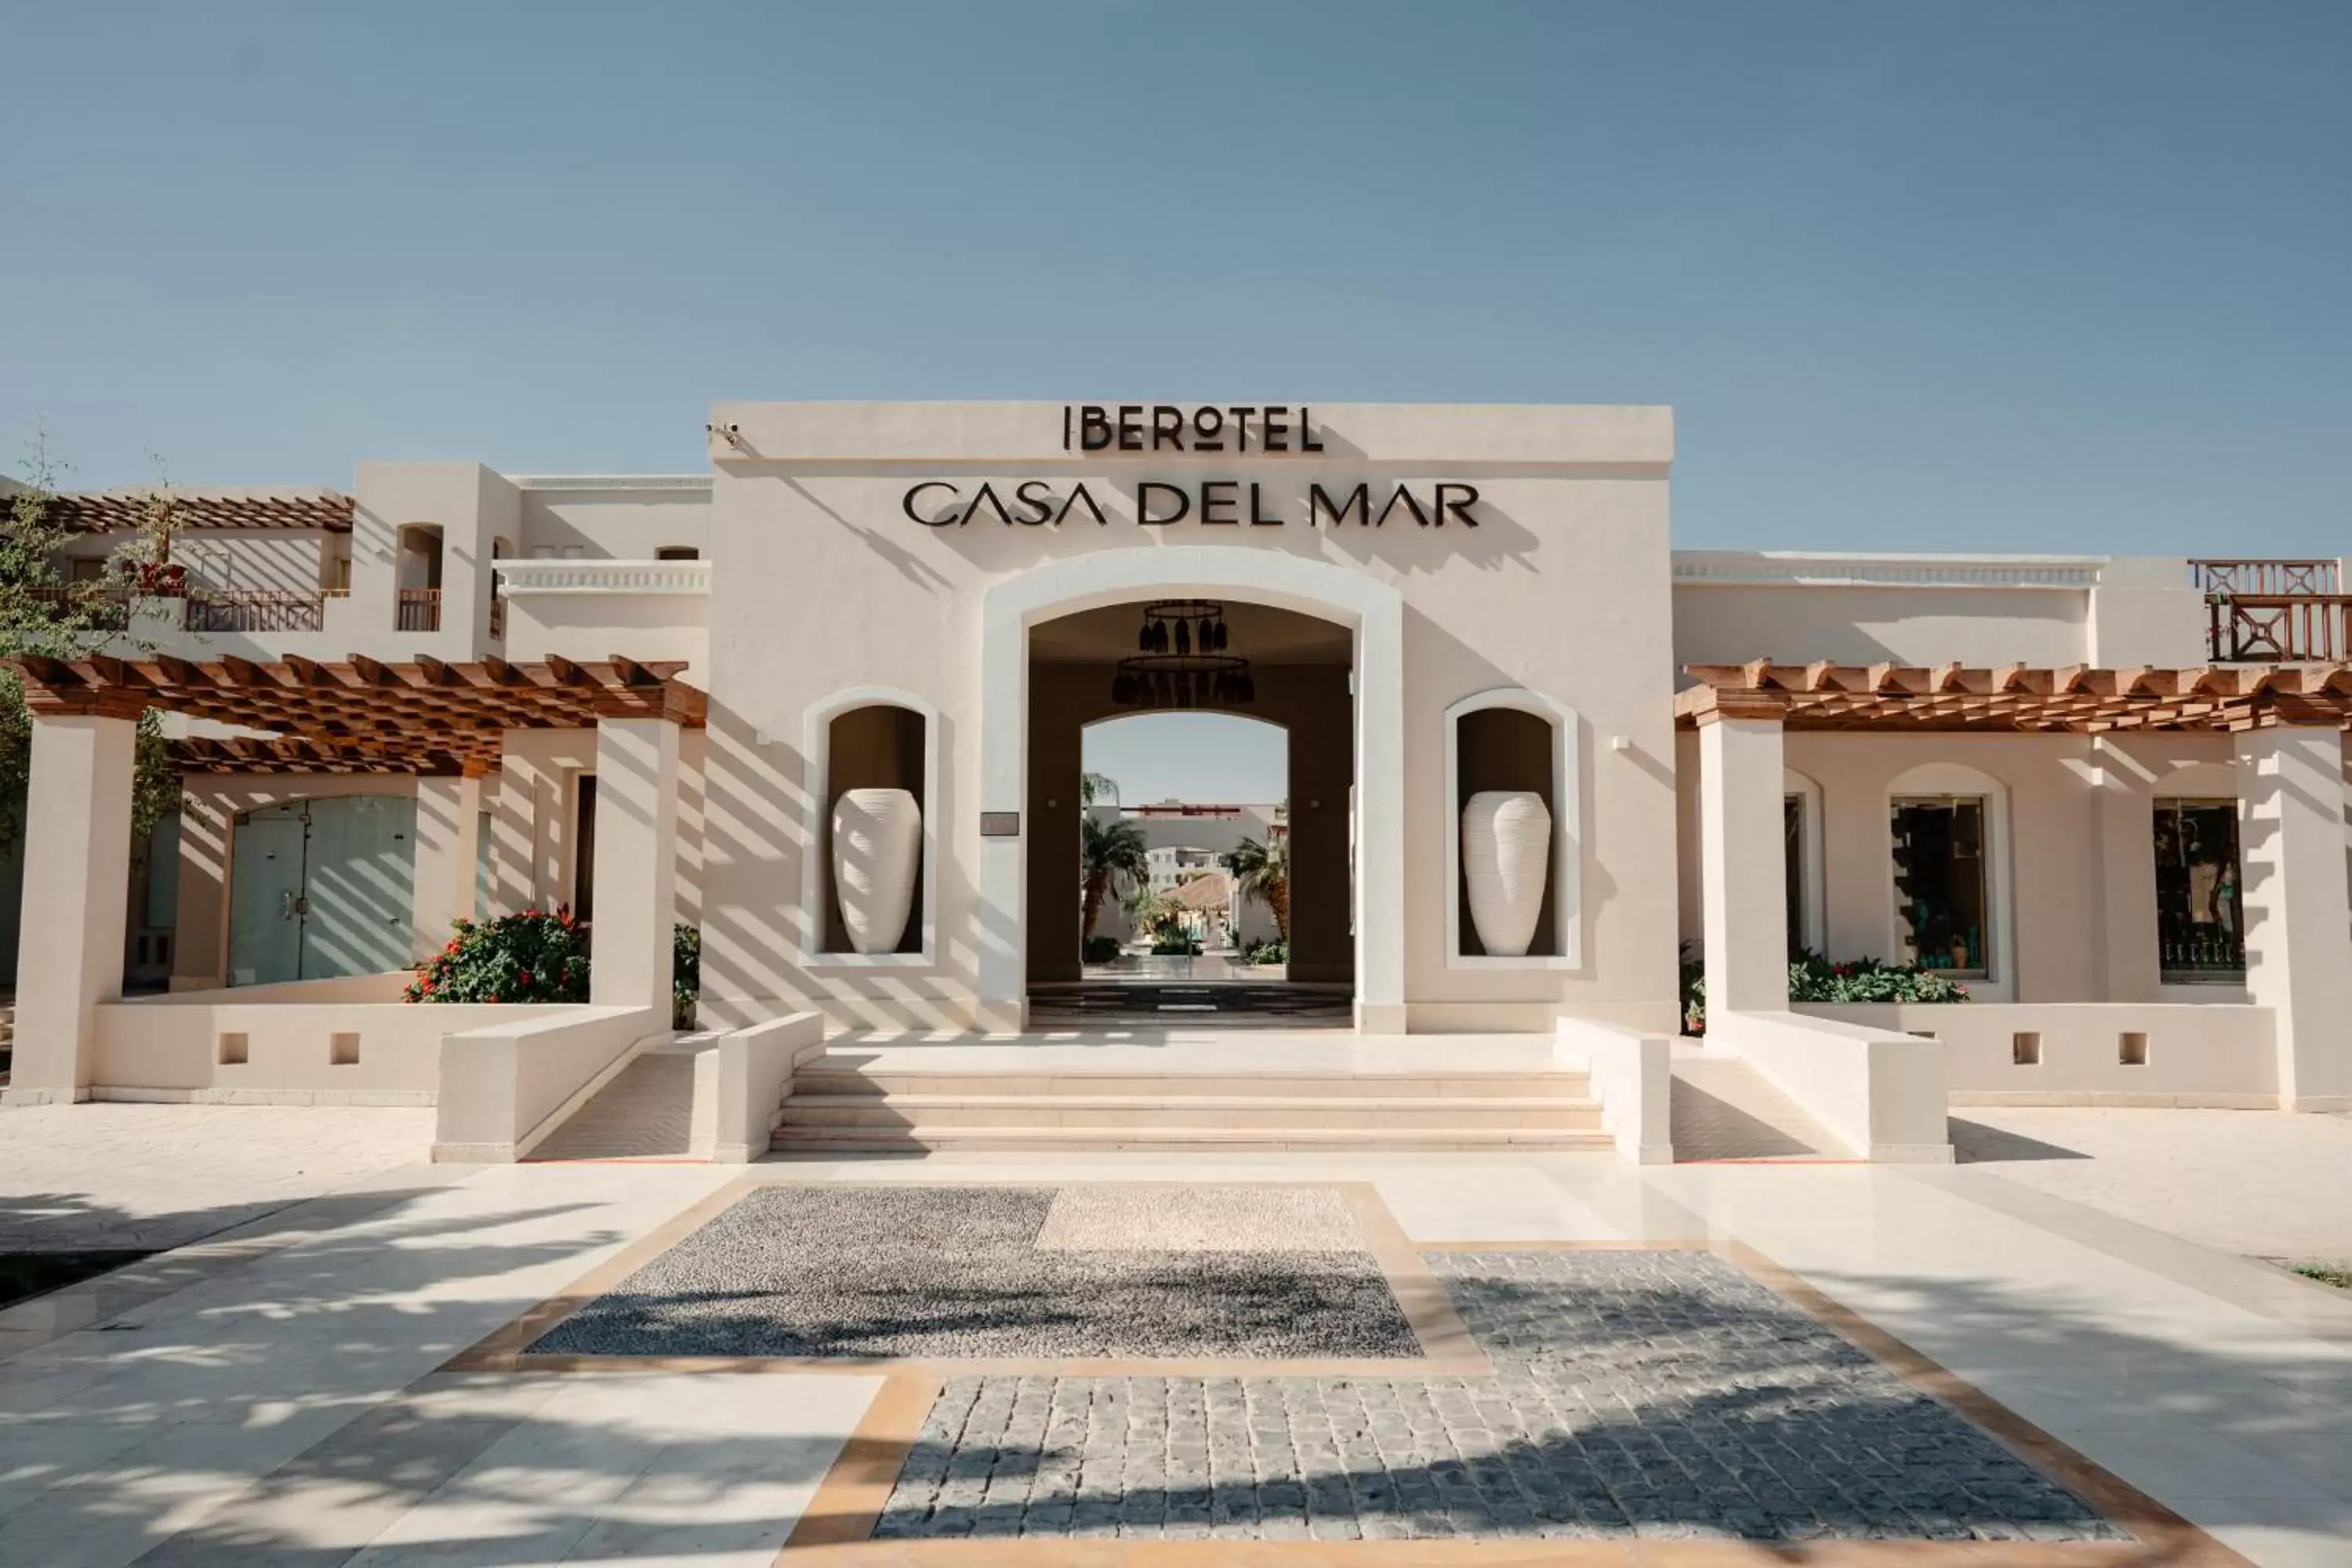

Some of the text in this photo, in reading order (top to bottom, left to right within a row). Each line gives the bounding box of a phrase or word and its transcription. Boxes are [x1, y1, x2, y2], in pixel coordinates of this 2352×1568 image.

[1063, 405, 1324, 452] IBEROTEL
[902, 481, 1480, 528] CASA DEL MAR
